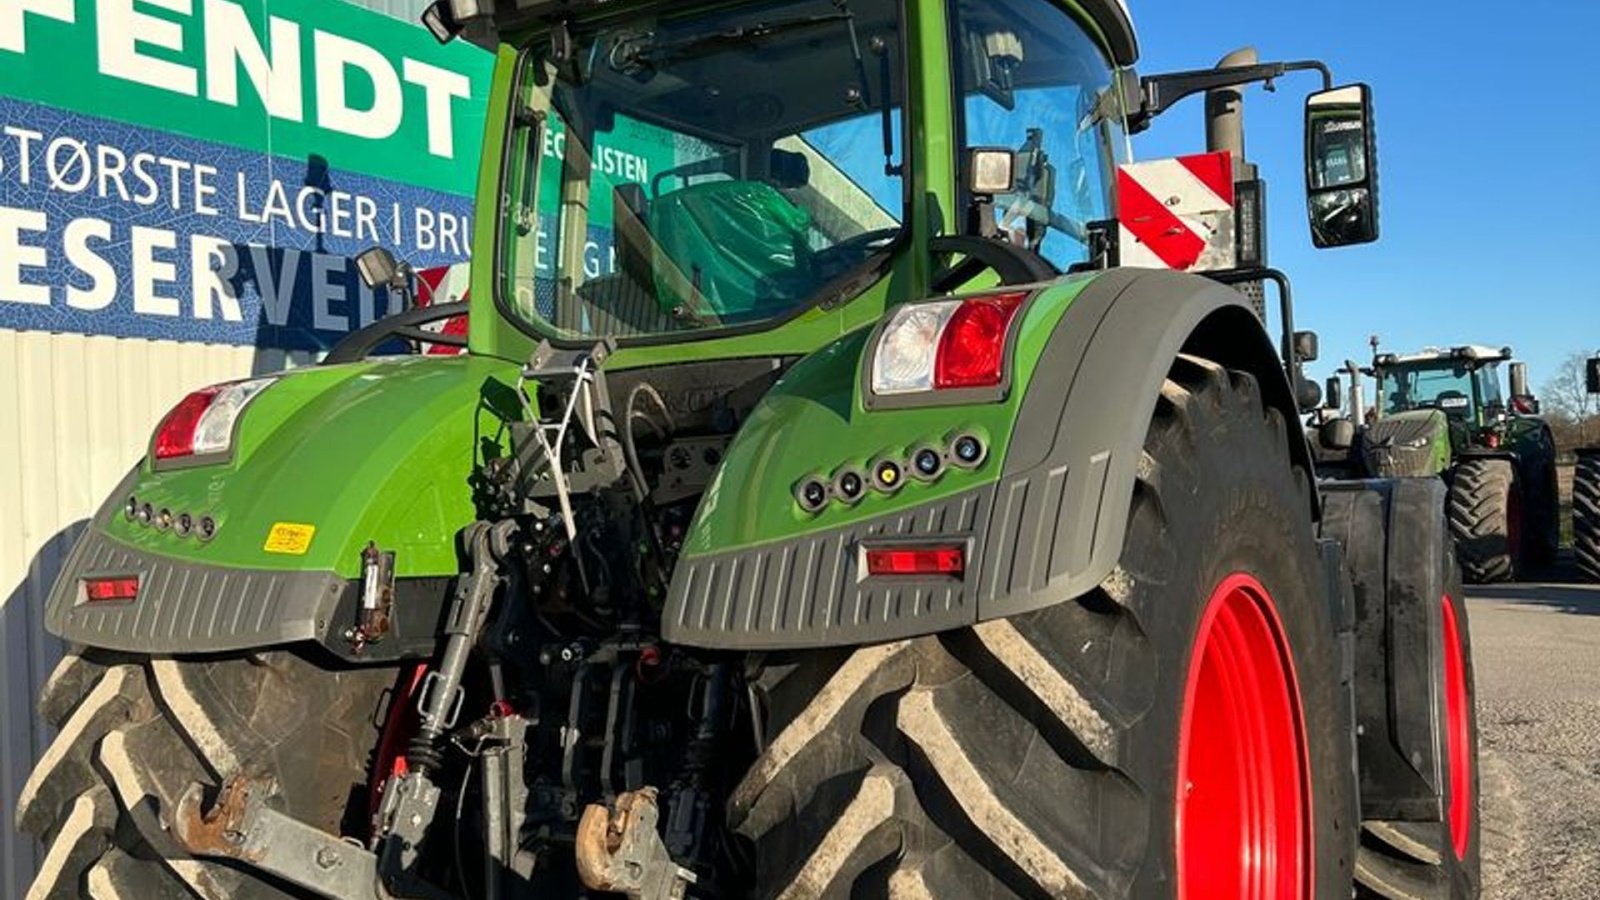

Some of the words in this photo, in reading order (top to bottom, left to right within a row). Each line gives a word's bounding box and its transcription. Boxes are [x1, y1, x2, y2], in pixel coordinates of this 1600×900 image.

[0, 126, 219, 216] TØRSTE
[237, 171, 380, 243] LAGER
[393, 202, 401, 246] I
